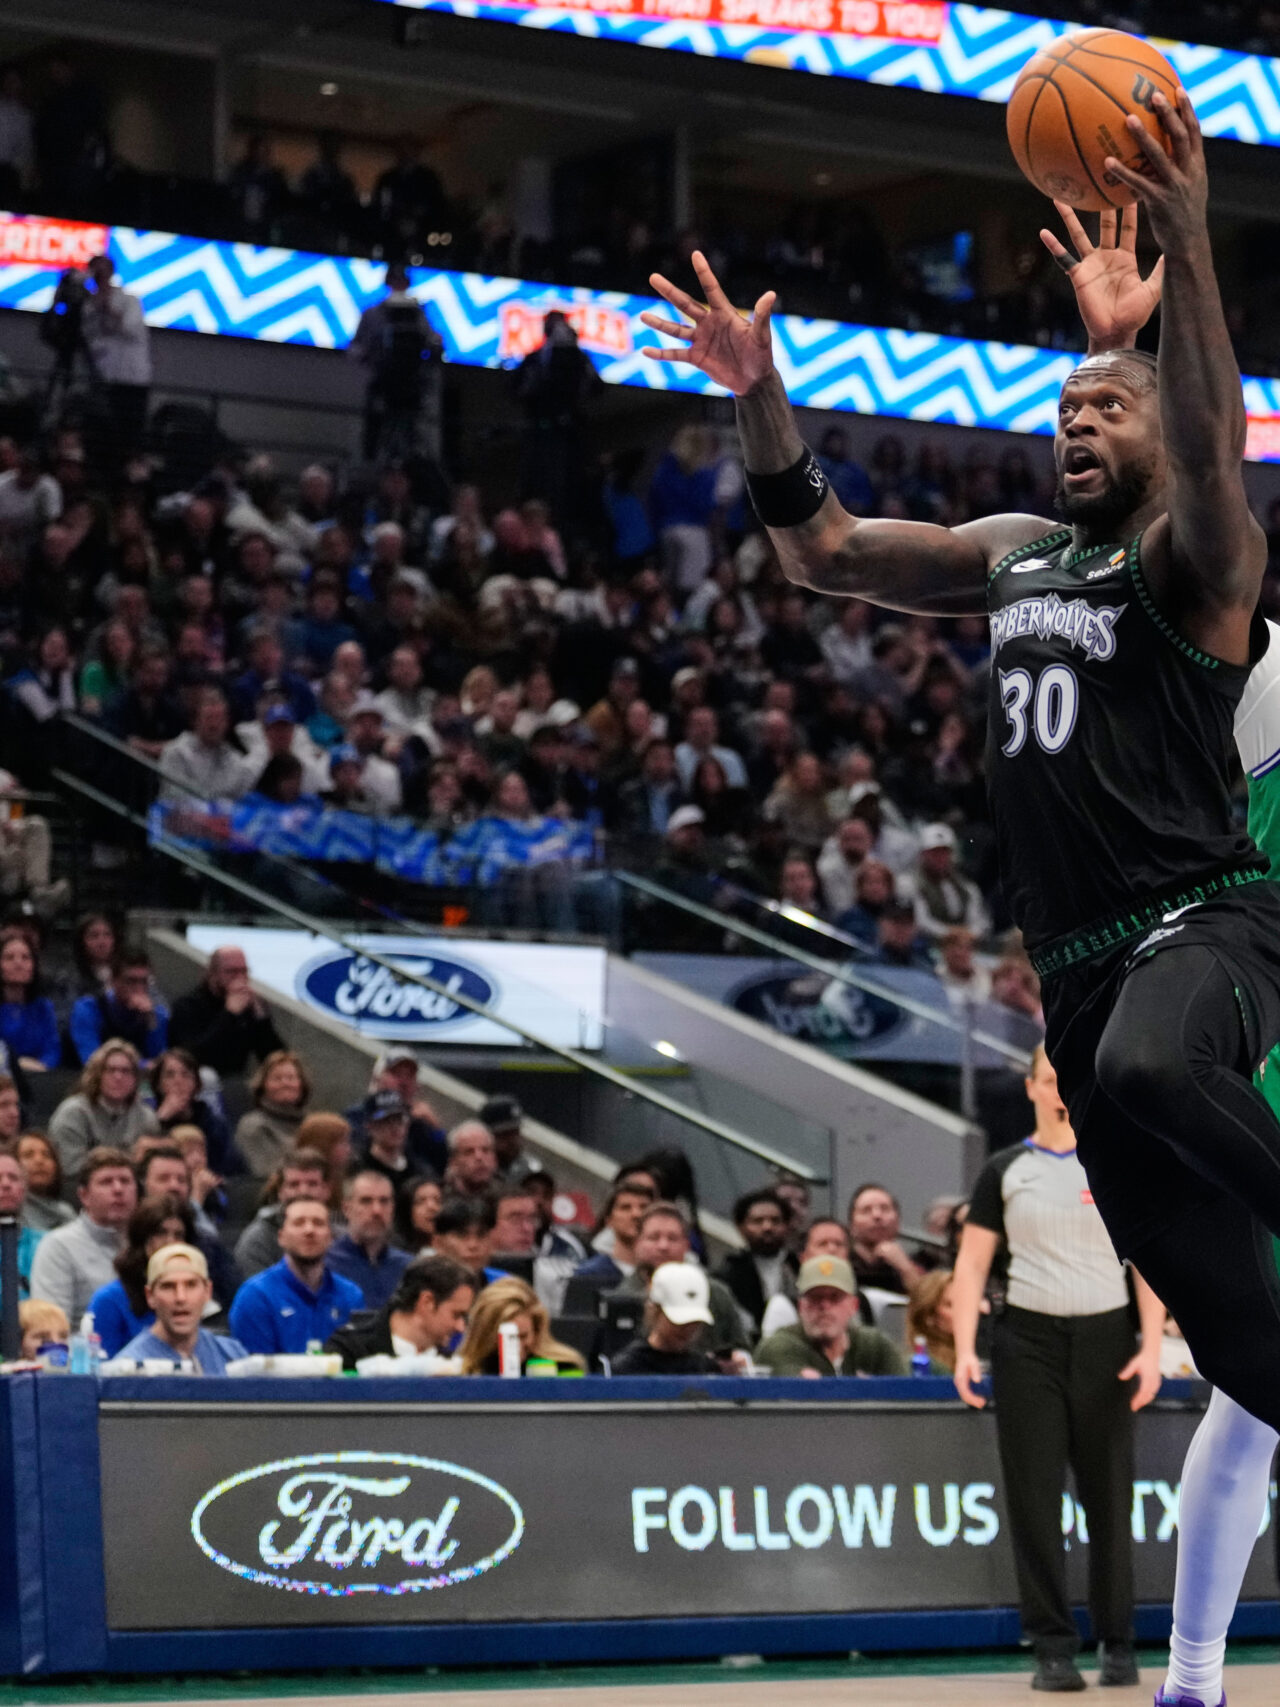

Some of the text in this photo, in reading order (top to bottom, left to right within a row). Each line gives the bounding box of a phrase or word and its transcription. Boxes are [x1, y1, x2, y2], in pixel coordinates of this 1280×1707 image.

[721, 0, 832, 29] SPEAKS
[838, 0, 878, 32] TO
[884, 2, 945, 37] YOU
[0, 224, 105, 263] RICKS
[998, 663, 1079, 757] 30
[258, 1470, 461, 1570] Ford
[631, 1483, 897, 1553] FOLLOW
[913, 1482, 1001, 1546] US
